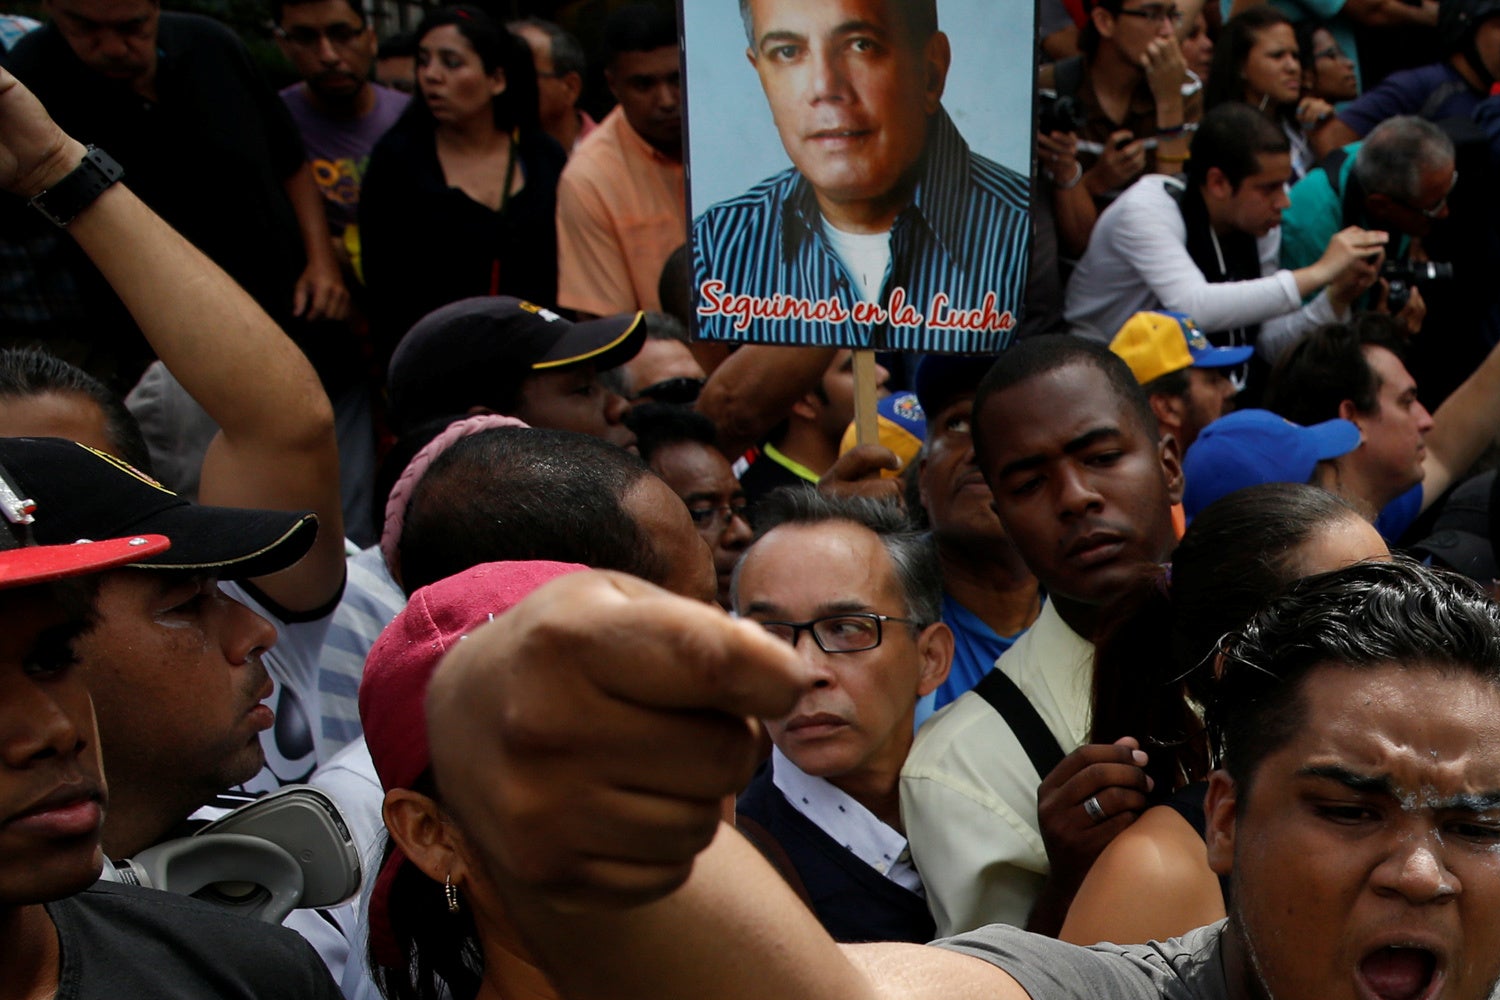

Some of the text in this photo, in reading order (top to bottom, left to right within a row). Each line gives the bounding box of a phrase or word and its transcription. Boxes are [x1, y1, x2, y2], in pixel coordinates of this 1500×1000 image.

[697, 279, 1017, 333] Seguimos en la Lucha
